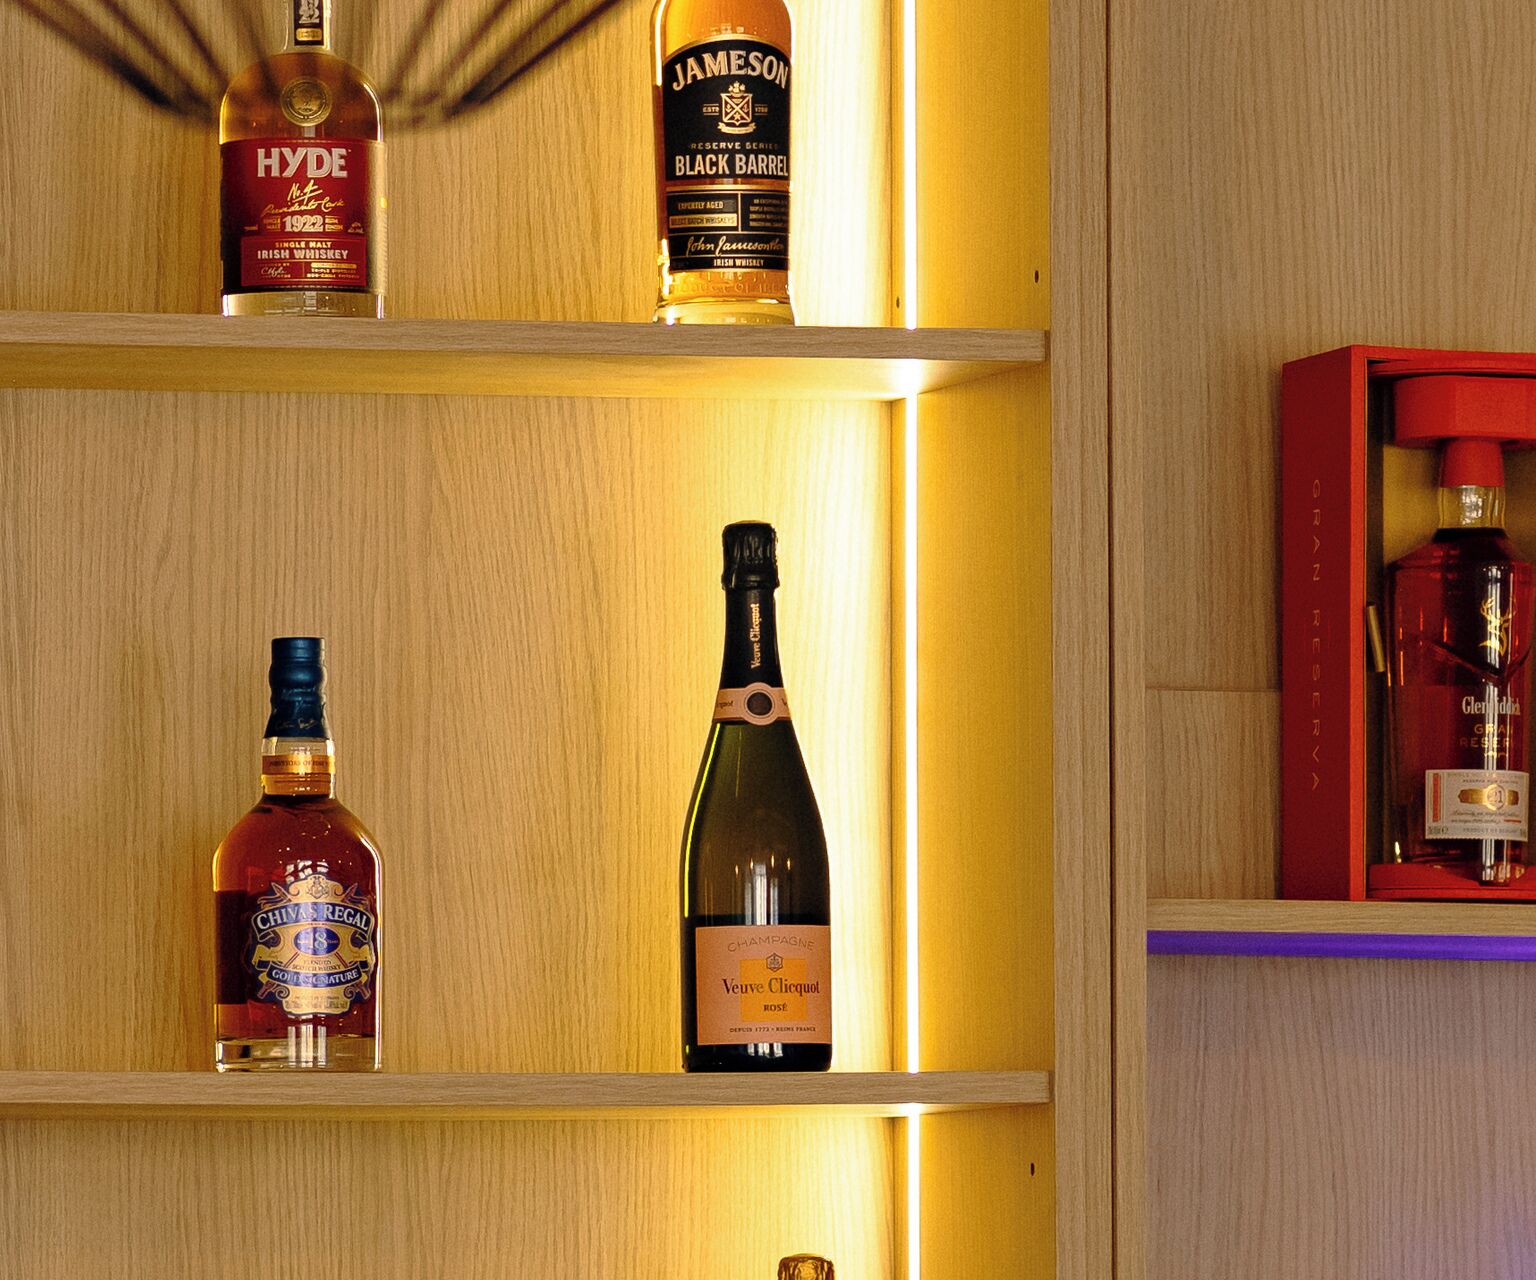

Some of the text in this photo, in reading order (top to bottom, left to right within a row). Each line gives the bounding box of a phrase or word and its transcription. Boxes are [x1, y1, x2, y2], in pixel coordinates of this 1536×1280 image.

[671, 49, 790, 92] JAMESON
[690, 141, 742, 151] RESERVE
[256, 146, 349, 179] HYDE
[675, 153, 789, 177] BLACK BARREL
[705, 200, 724, 209] AGED
[282, 214, 324, 233] 1922
[256, 249, 350, 260] IRISH WHISKEY
[275, 241, 333, 249] SINGLE MALT
[713, 259, 765, 268] IRISH WHISKEY
[1311, 478, 1321, 583] GRAN
[1310, 609, 1322, 791] RESERVA
[255, 904, 370, 932] CHIVAS REGAL
[727, 935, 816, 953] CHAMPAGNE
[721, 977, 821, 998] Veuve Clicquot
[763, 1002, 789, 1013] ROSÉ
